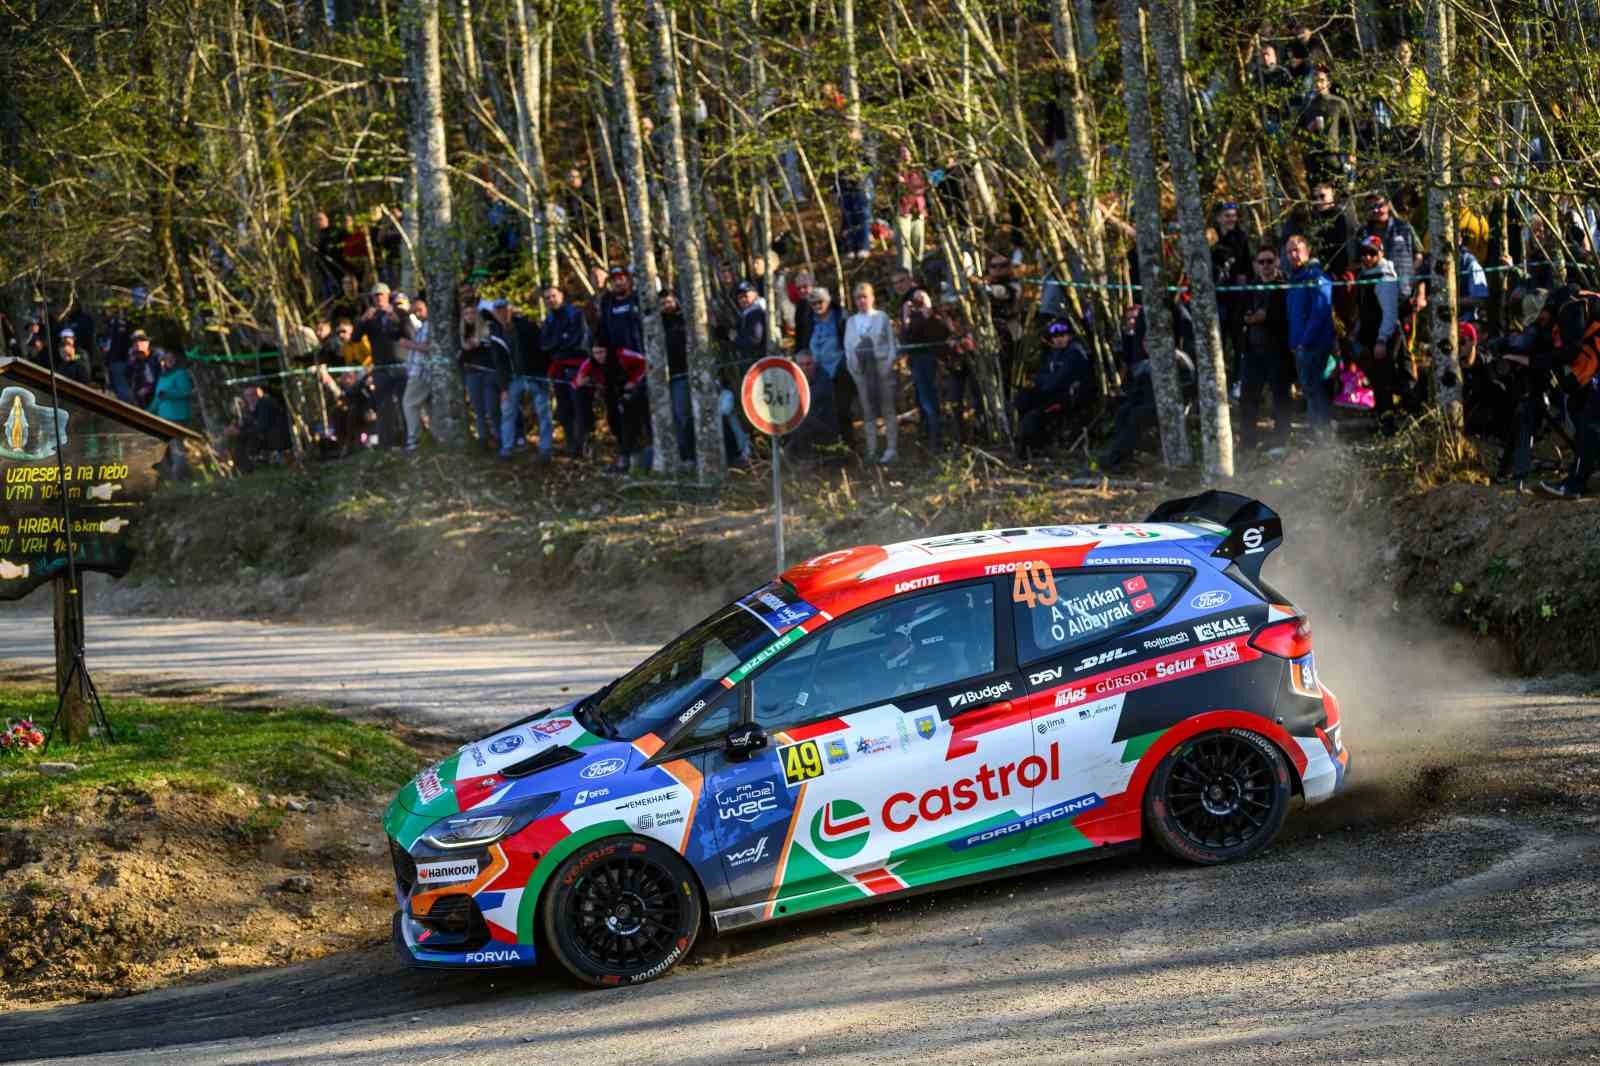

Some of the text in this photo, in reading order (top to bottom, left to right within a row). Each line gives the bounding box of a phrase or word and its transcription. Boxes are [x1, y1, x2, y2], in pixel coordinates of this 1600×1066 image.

[77, 466, 94, 480] na
[99, 463, 128, 480] nebo
[21, 536, 48, 553] VRH
[895, 575, 942, 593] LOCTITE
[1013, 559, 1057, 608] 49
[1051, 586, 1124, 622] A Türkkan
[1051, 602, 1133, 641] O Albayrak
[1212, 616, 1248, 632] KALE
[1079, 648, 1124, 669] DHL
[1204, 643, 1237, 660] NGK
[1029, 666, 1063, 686] DSV
[1155, 657, 1197, 678] Setur
[966, 681, 1014, 703] Budget
[1095, 670, 1149, 694] GÜRSOY
[1055, 688, 1088, 708] MARS
[587, 762, 618, 777] Ford
[786, 741, 823, 782] 49
[721, 787, 771, 805] JUNIOR
[881, 741, 1060, 833] Castrol
[720, 796, 778, 820] WRC
[967, 797, 1096, 845] FORD RACING
[465, 950, 520, 963] FORVIA
